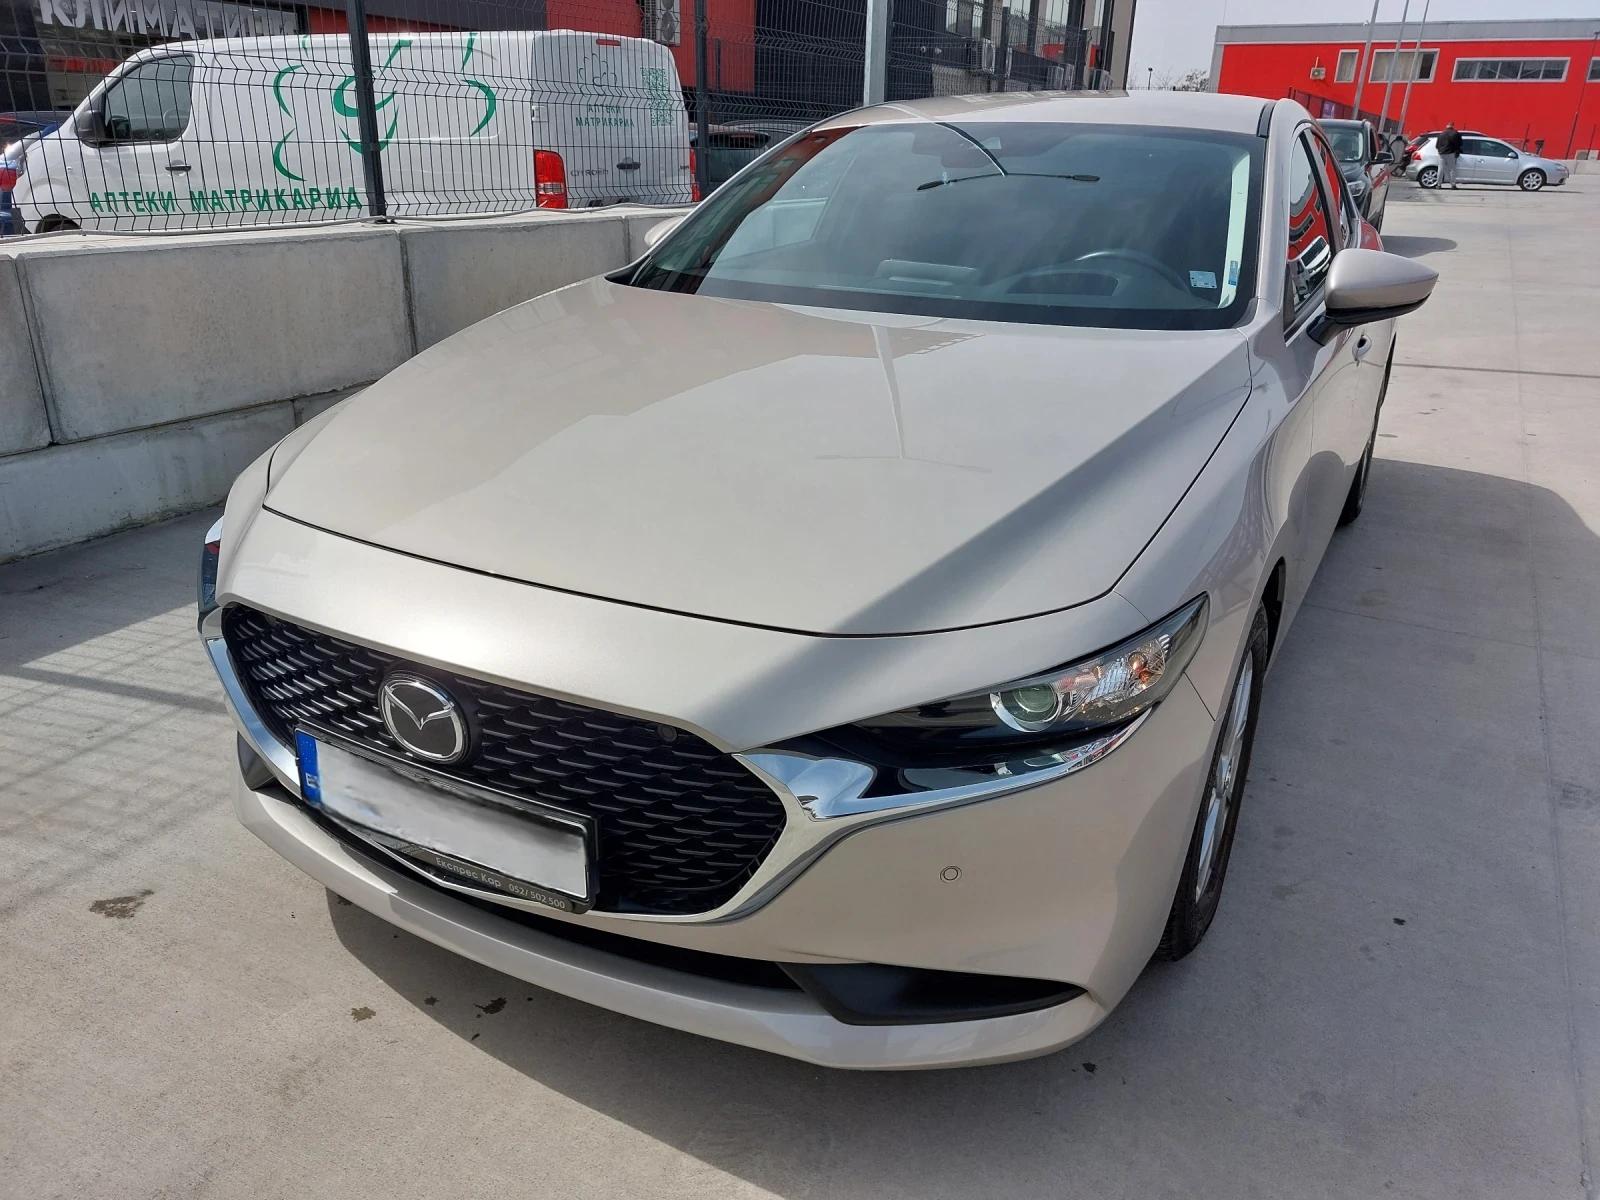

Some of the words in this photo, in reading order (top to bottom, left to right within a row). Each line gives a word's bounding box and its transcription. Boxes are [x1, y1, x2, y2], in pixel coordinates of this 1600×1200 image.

[91, 191, 176, 213] АПТЕКИ
[189, 187, 363, 212] МАТРИКАРИА
[435, 857, 479, 880] Експрес
[481, 873, 502, 888] Кар
[508, 883, 529, 897] 052/
[530, 890, 547, 902] 502
[549, 898, 566, 910] 500
